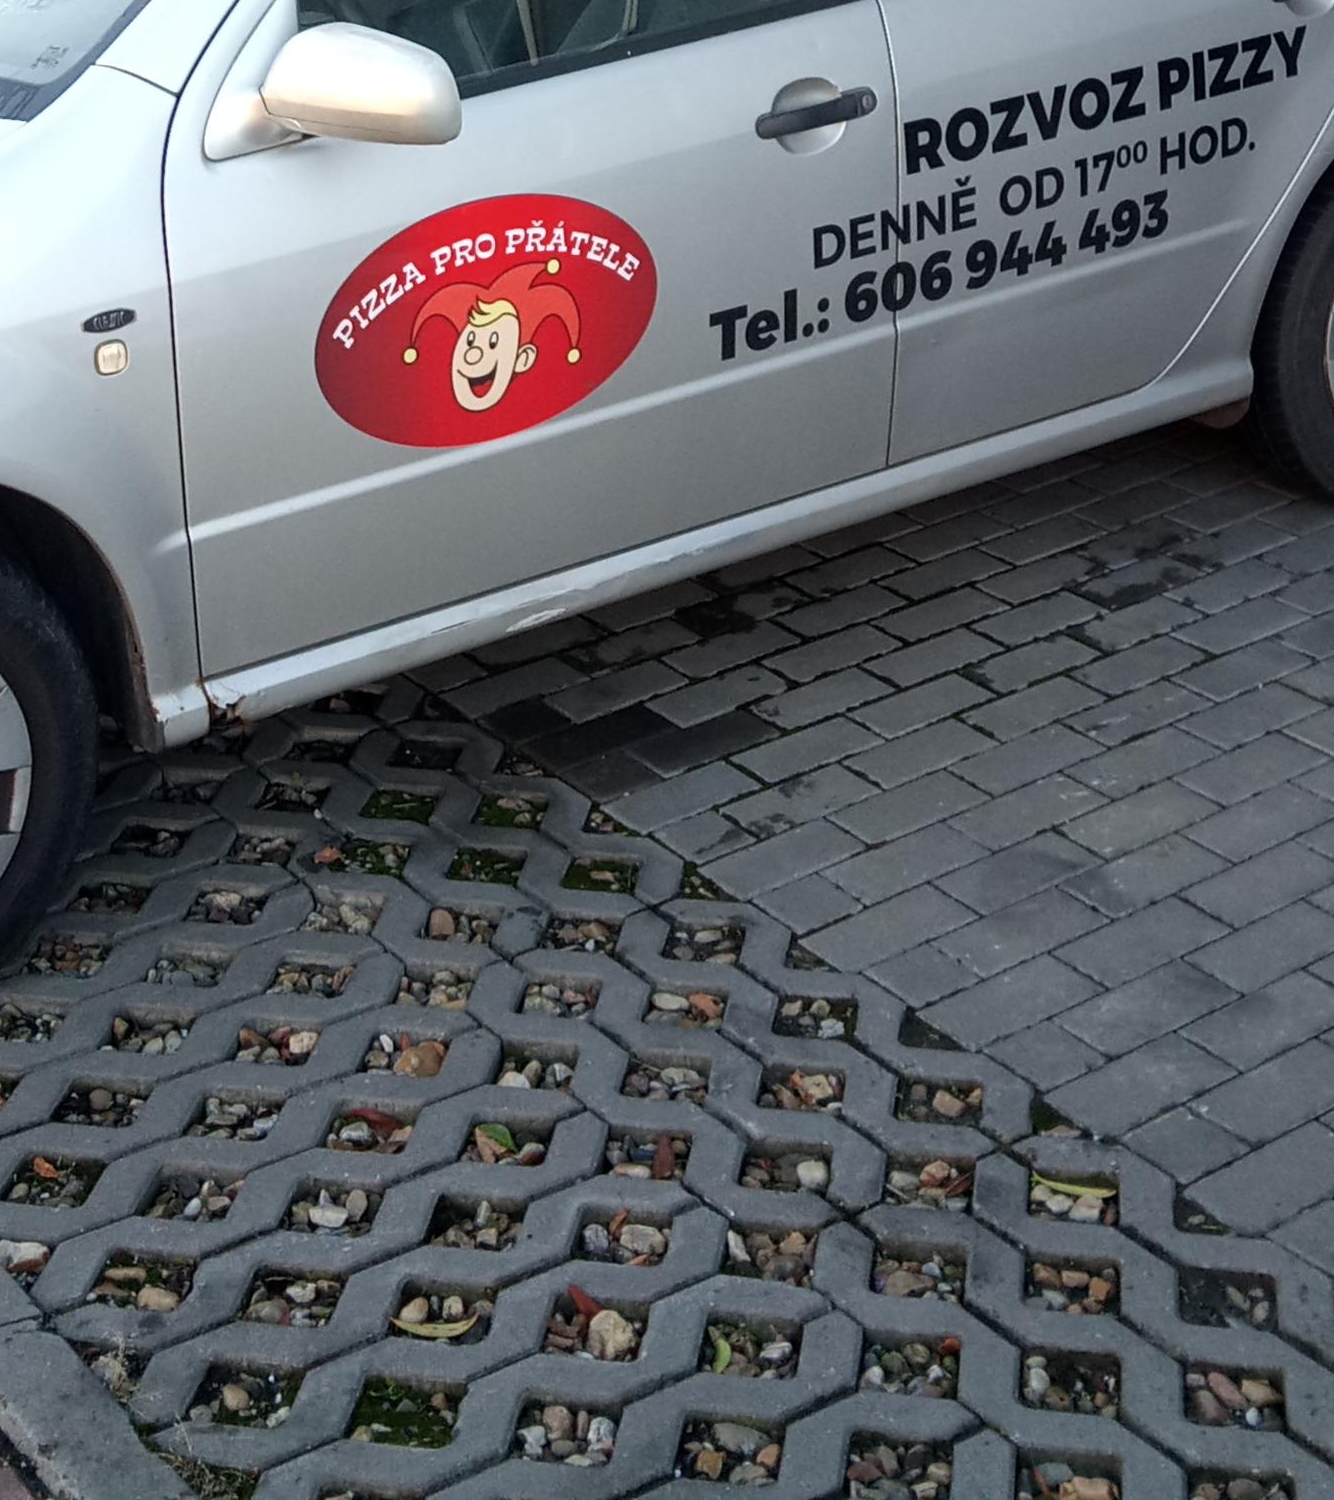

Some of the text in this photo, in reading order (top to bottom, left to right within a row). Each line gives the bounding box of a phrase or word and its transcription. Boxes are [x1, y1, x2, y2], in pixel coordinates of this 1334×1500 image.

[903, 25, 1308, 176] ROZVOZ PIZZY
[812, 174, 978, 270] DENNĚ
[999, 166, 1065, 217] OD
[1159, 116, 1256, 176] HOD.
[332, 219, 641, 350] PIZZA PRO PŘÁTELE
[708, 189, 1169, 362] Tel.: 606 944 493
